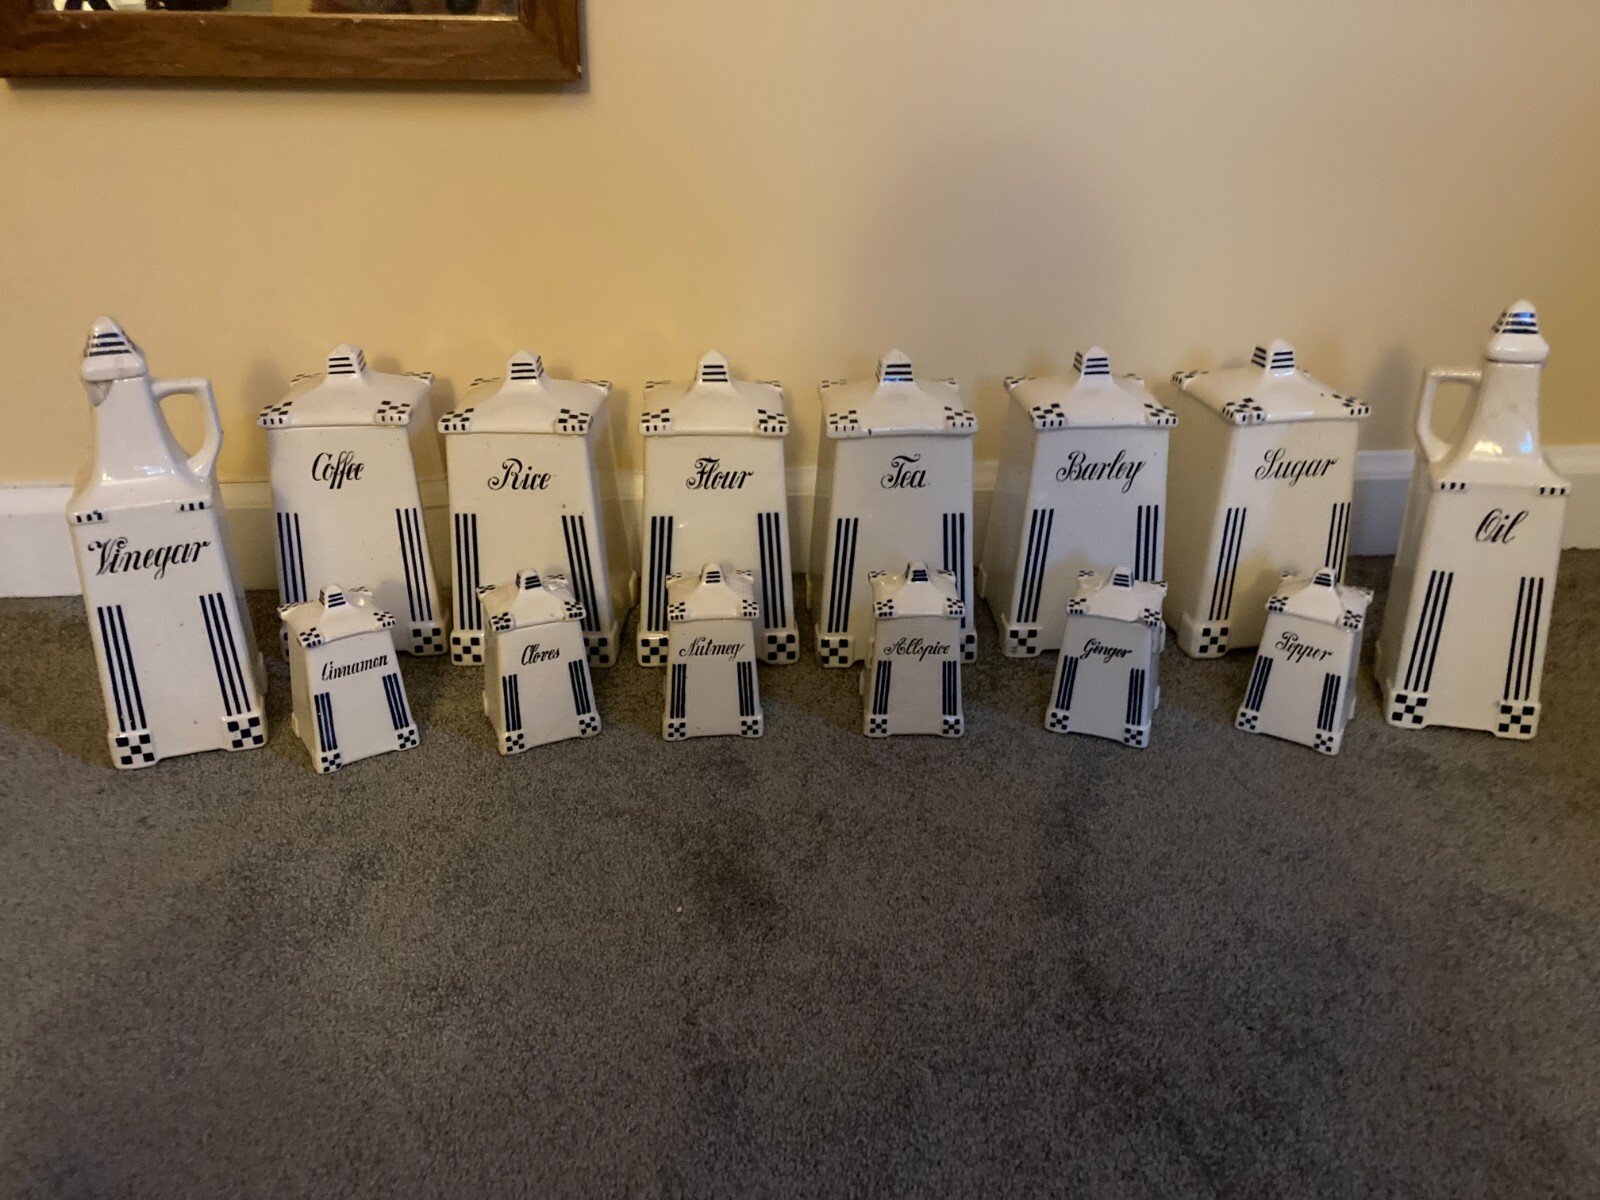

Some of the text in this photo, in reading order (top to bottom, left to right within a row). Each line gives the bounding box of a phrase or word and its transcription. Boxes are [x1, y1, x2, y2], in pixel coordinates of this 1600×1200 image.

[311, 450, 365, 490] Coffee
[487, 457, 553, 491] Rice
[685, 457, 755, 491] Flour
[880, 453, 927, 489] Tea
[1055, 449, 1147, 494] Barley
[1254, 447, 1339, 488] Sugar
[1474, 508, 1530, 545] Oil
[87, 536, 212, 581] Vinegar
[520, 643, 562, 666] Cloves
[679, 636, 746, 662] Nutmeg
[884, 637, 952, 662] Allspice
[1079, 637, 1134, 664] Ginger
[1275, 631, 1335, 664] Pepper
[321, 654, 389, 681] Cinnamon
